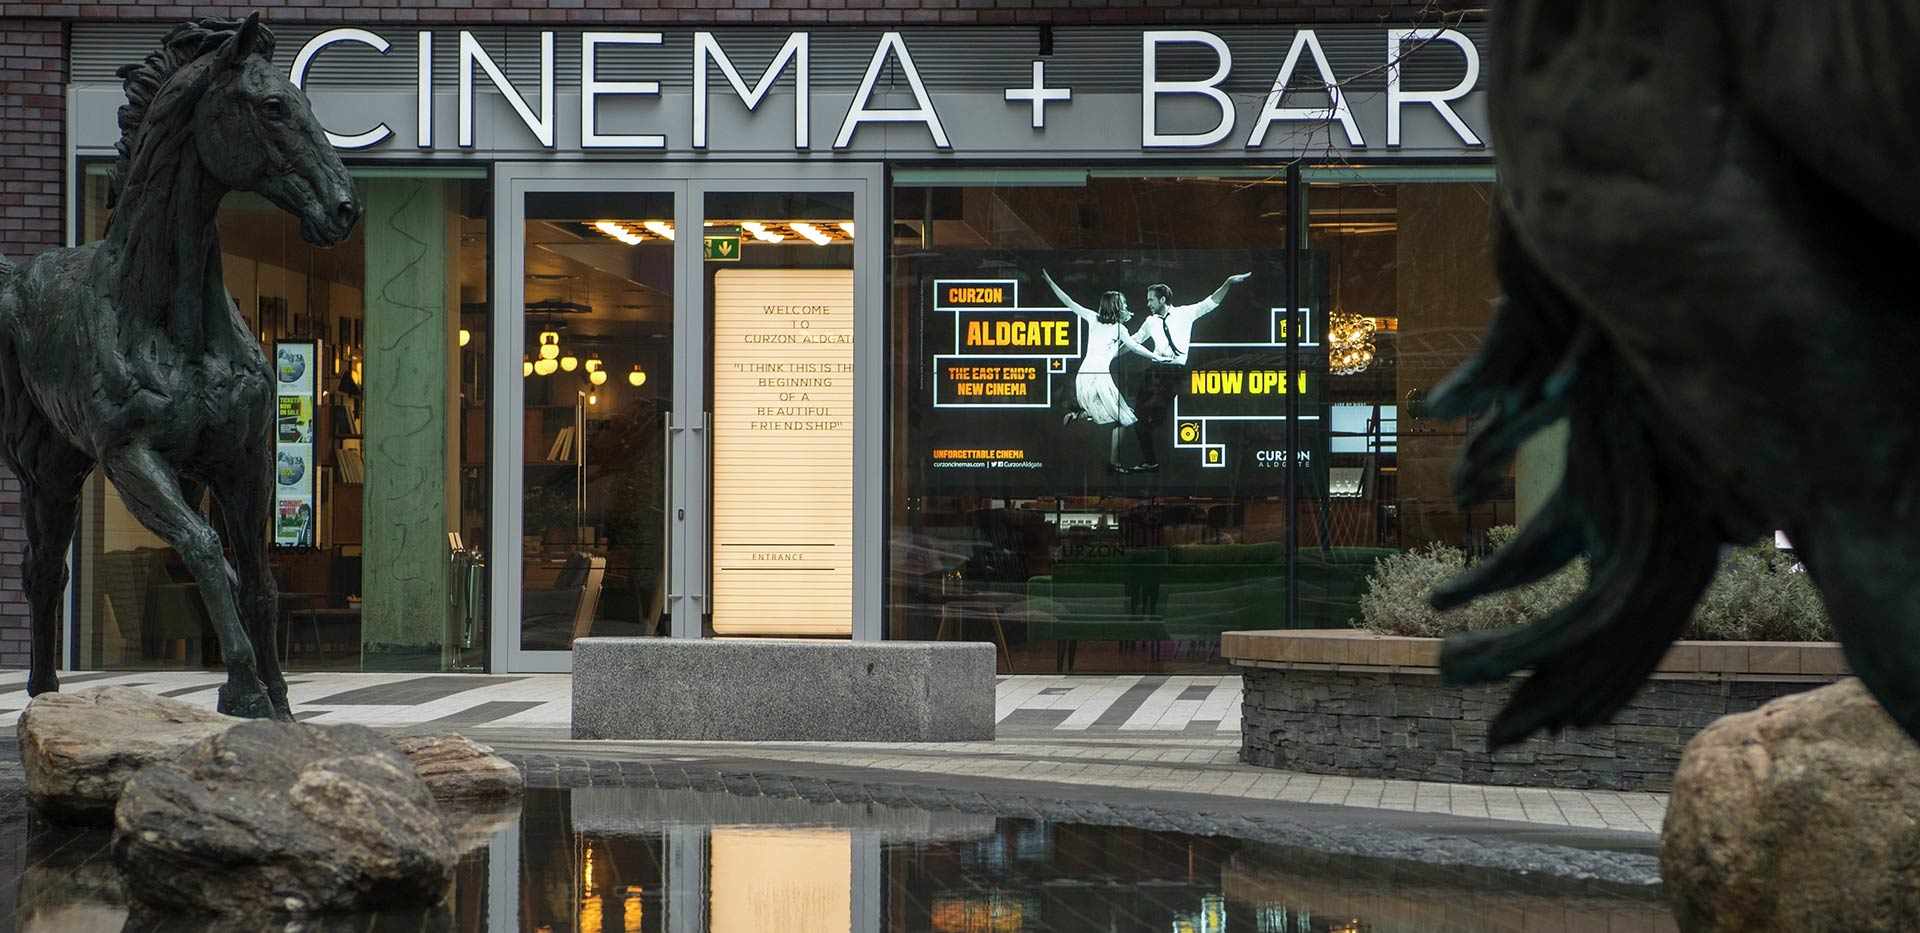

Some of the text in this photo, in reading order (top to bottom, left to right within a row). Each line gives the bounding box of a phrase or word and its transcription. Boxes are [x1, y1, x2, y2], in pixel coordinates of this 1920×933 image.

[289, 28, 952, 151] CINEMA
[1142, 29, 1485, 149] BAR
[948, 287, 1003, 304] CURZON
[763, 305, 831, 315] WELCOME
[792, 319, 810, 330] TO
[966, 320, 1070, 346] ALDGATE
[744, 334, 854, 344] CURZON ALDGAT
[749, 362, 784, 373] THINK
[789, 362, 817, 373] THIS
[820, 362, 832, 373] IS
[948, 367, 1036, 380] THE EAST END'S
[758, 377, 832, 388] BEGINNING
[1191, 370, 1243, 394] NOW
[957, 383, 1027, 396] NEW CINEMA
[779, 392, 810, 402] OF A
[757, 406, 830, 417] BEAUTIFUL
[933, 449, 1024, 459] UNFORGETTABLE CINEMA
[752, 553, 803, 561] ENTRANCE
